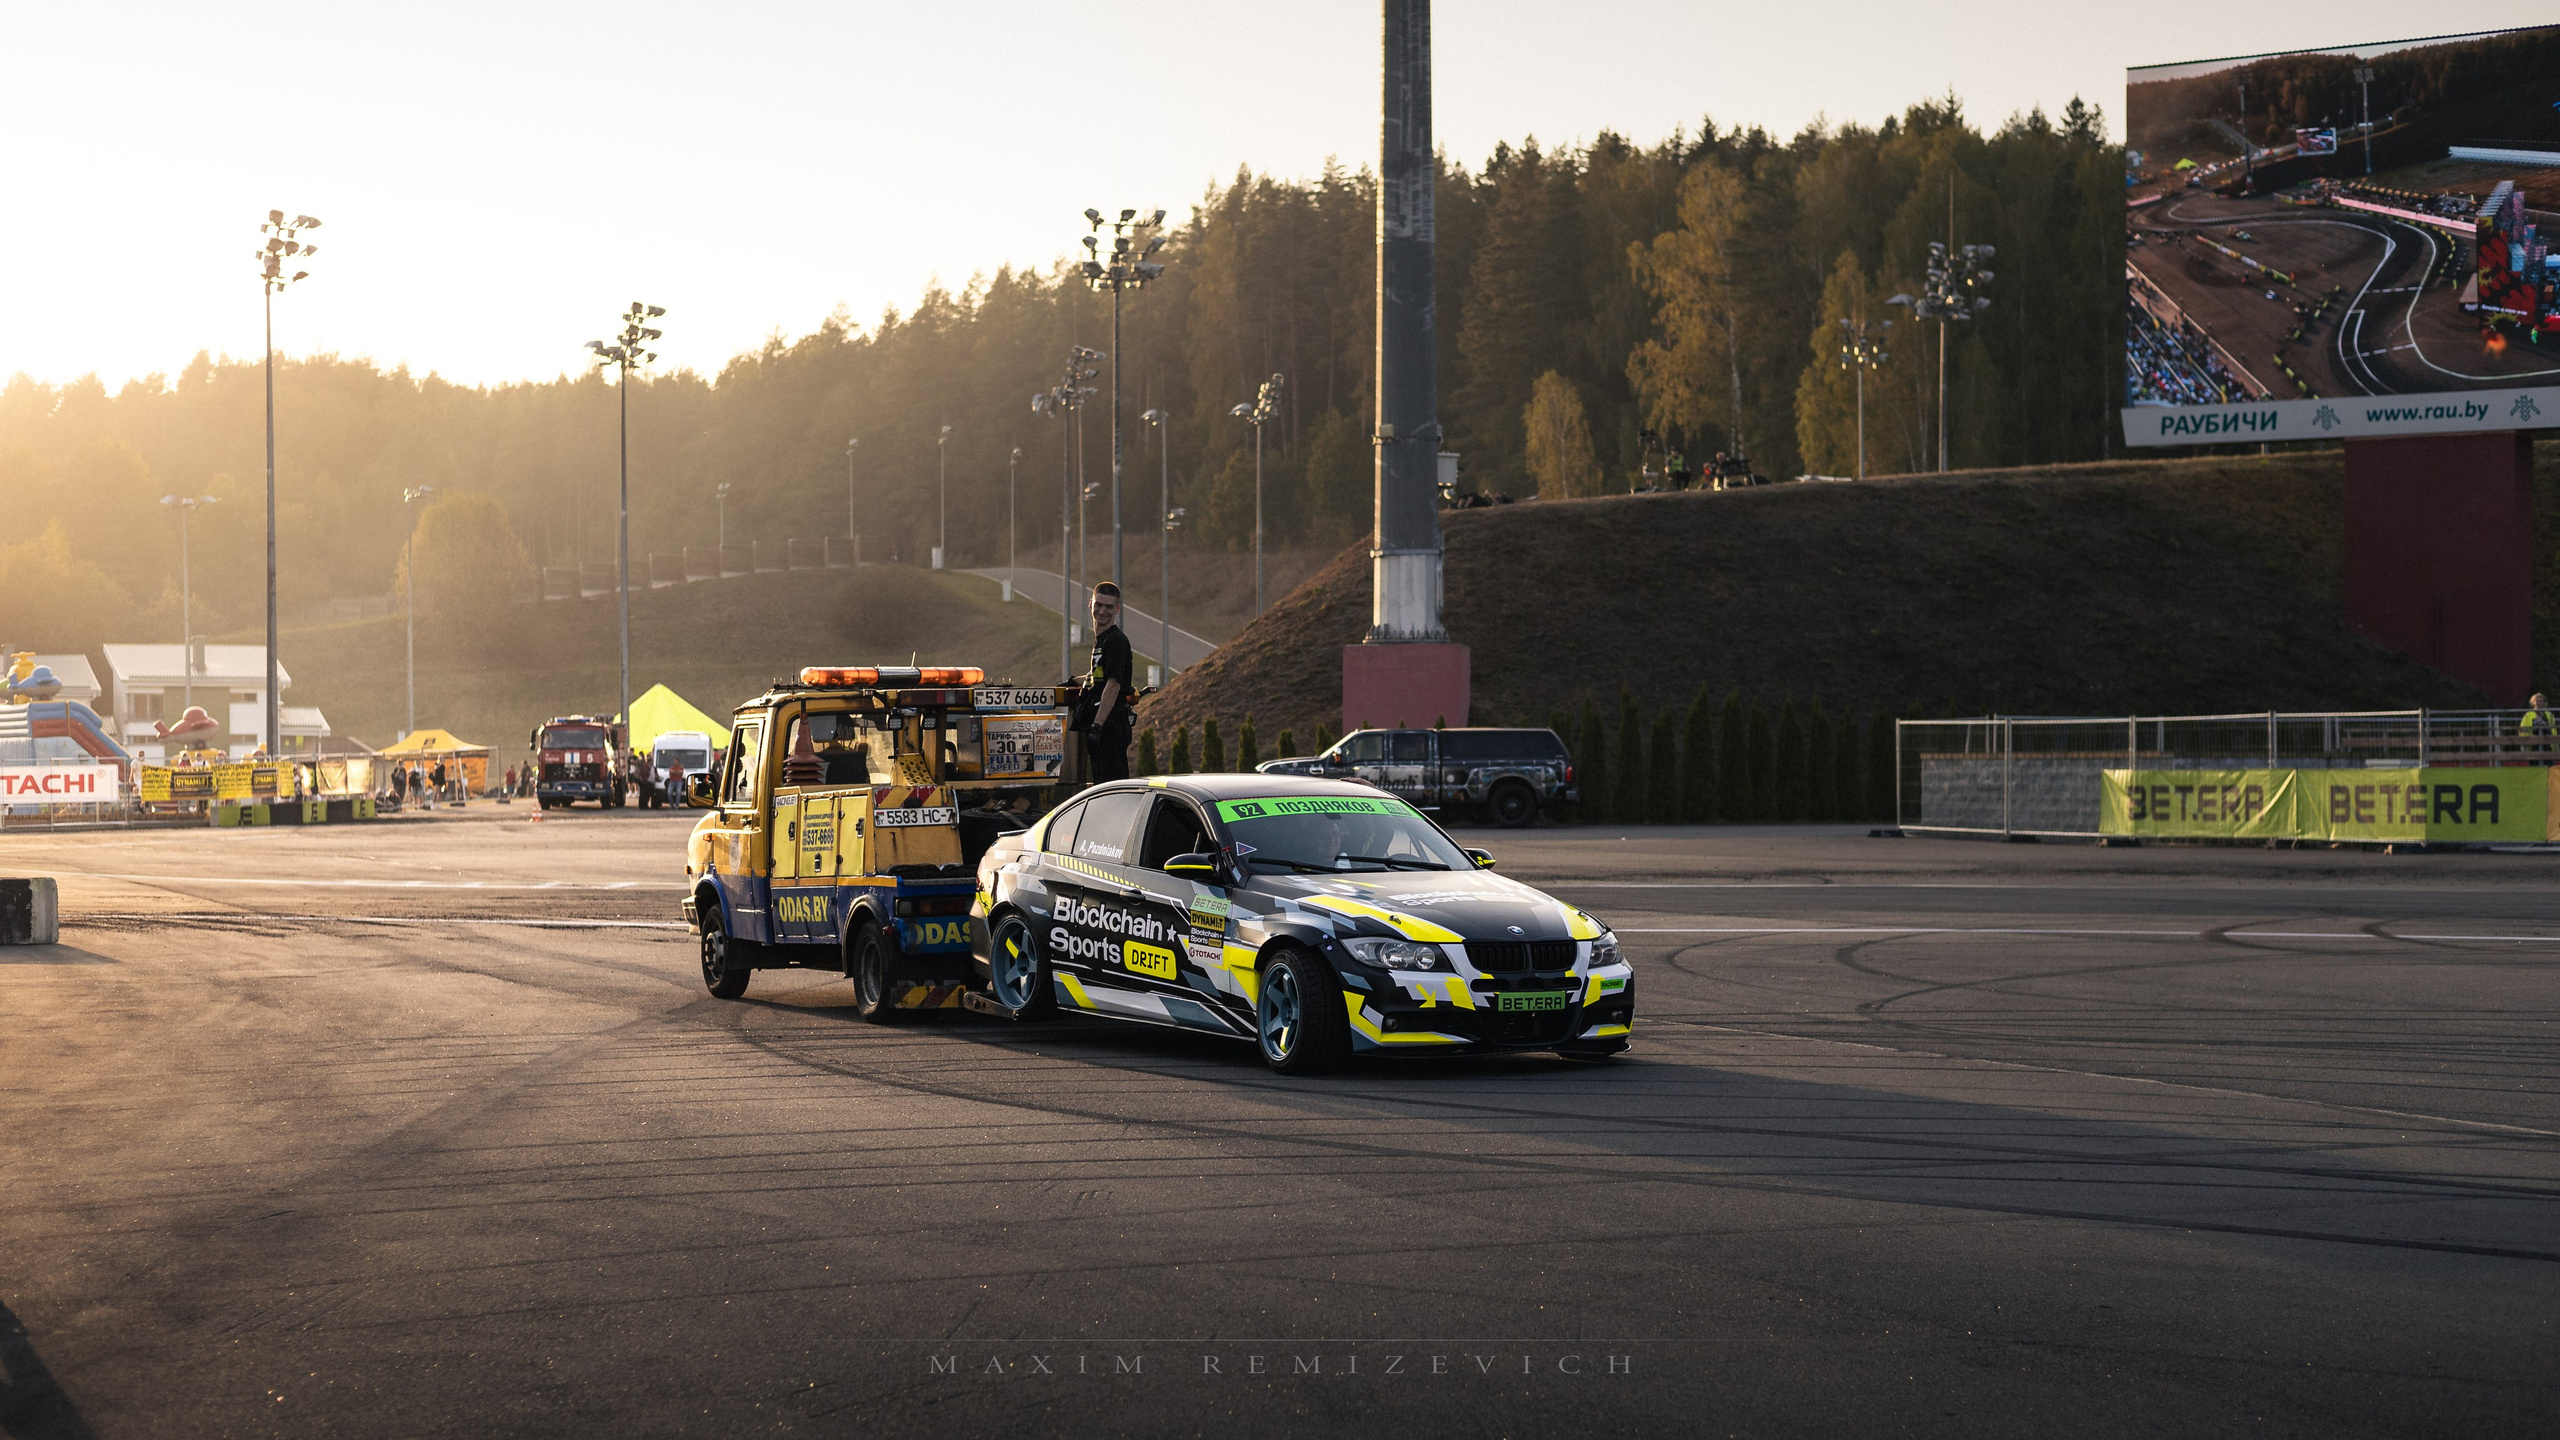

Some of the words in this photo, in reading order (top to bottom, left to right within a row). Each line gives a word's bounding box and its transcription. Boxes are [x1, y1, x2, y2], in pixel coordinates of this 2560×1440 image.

[2366, 400, 2489, 423] www.rau.by
[2160, 410, 2278, 436] РАУБИЧИ
[985, 691, 1011, 705] 537
[1015, 690, 1047, 705] 6666
[988, 733, 1012, 741] ТАРИФ
[996, 740, 1017, 754] 30
[1035, 743, 1053, 751] ODAS
[989, 754, 1020, 765] FULL
[990, 763, 1020, 772] SPEED
[0, 774, 94, 795] TACHI
[1238, 804, 1258, 816] 92
[1274, 800, 1376, 814] ПОЗДНЯКОВ
[886, 810, 919, 824] 5583
[1087, 841, 1124, 859] Pozdniakov
[778, 895, 829, 923] ODAS.BY
[1053, 894, 1163, 941] Blockchain
[909, 921, 972, 945] ODAS
[1190, 927, 1220, 938] Blockchain
[1190, 935, 1209, 944] Sports
[1049, 926, 1122, 964] Sports
[1131, 949, 1169, 972] DRIFT
[1195, 949, 1221, 960] TOTACHI
